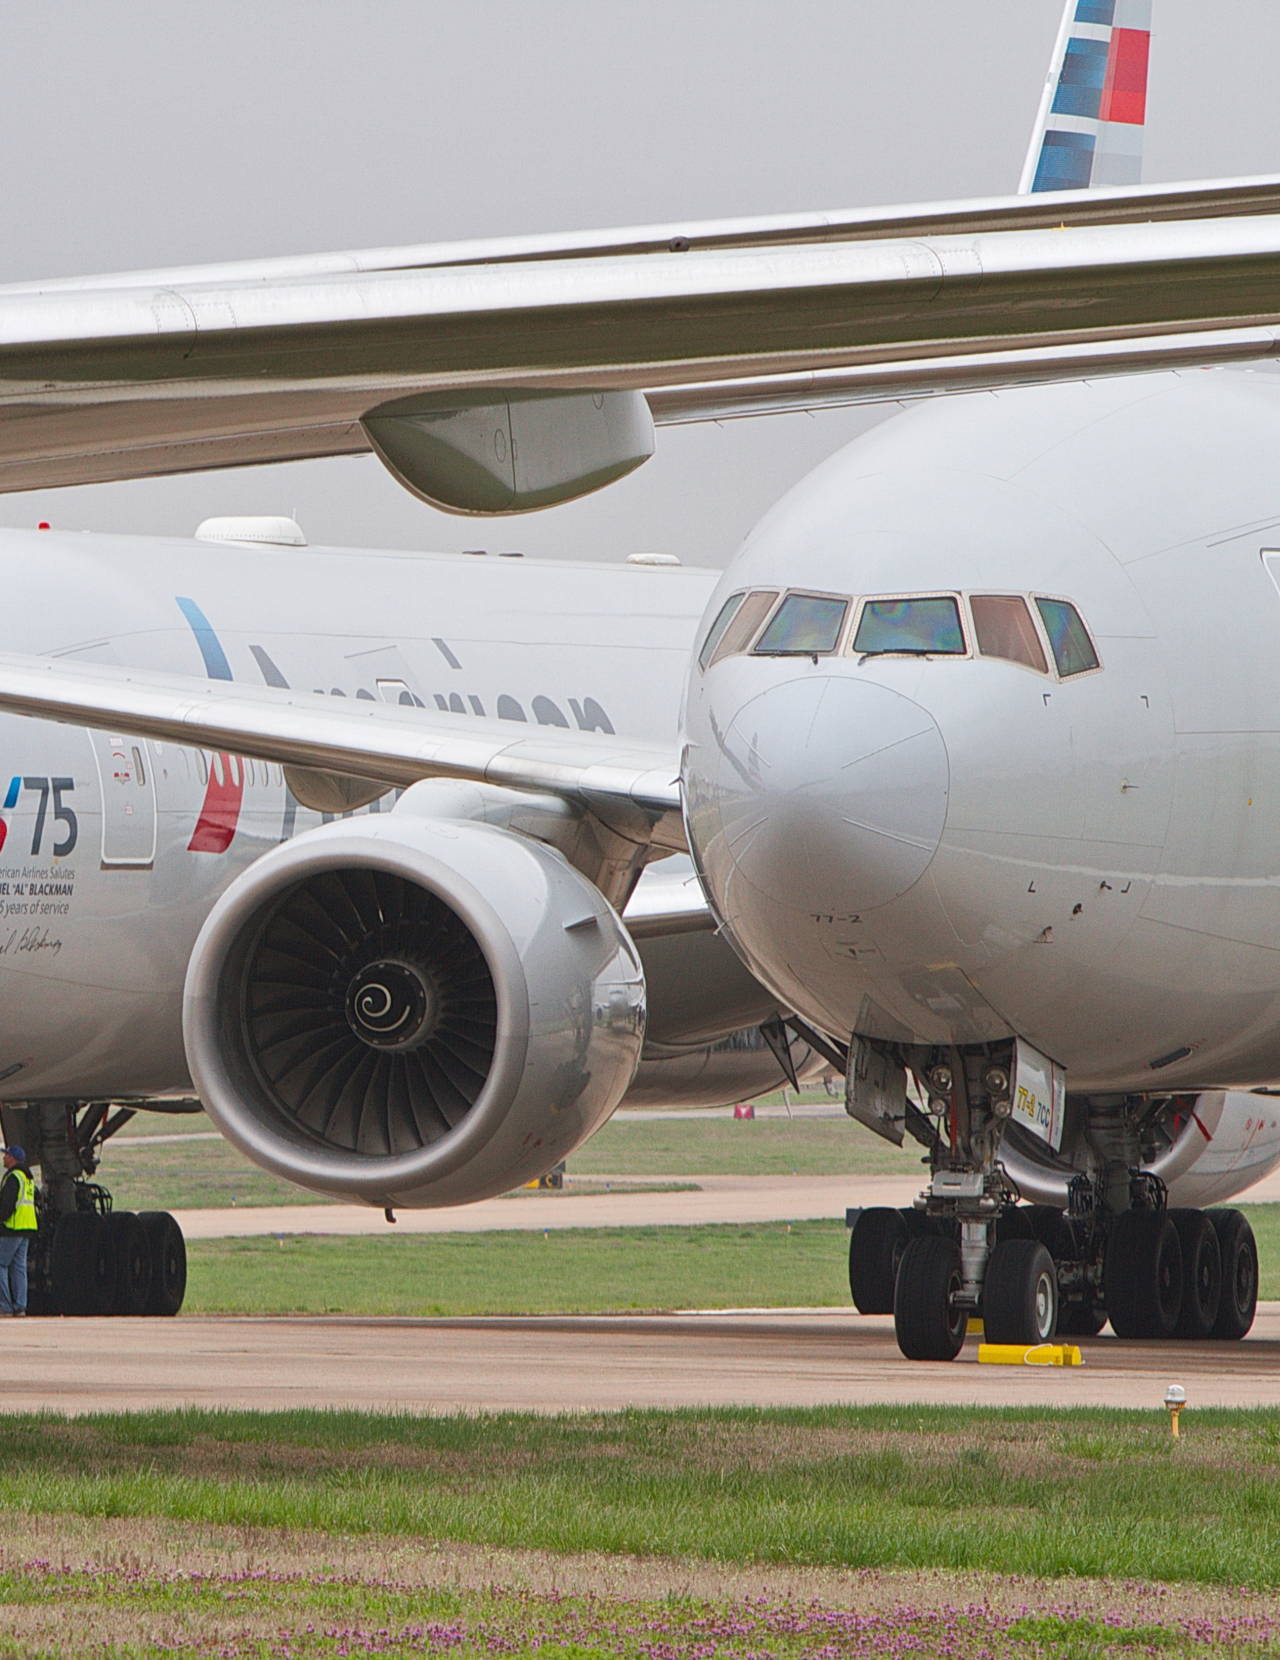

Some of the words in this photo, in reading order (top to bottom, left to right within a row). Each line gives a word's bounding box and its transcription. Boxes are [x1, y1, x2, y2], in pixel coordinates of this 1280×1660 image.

[23, 776, 78, 857] 75
[21, 866, 48, 880] Airlines
[50, 867, 76, 880] Salutes
[29, 883, 74, 897] BLACKMAN
[3, 902, 28, 919] years
[30, 899, 41, 915] of
[40, 900, 70, 915] service
[809, 913, 863, 924] 77-2
